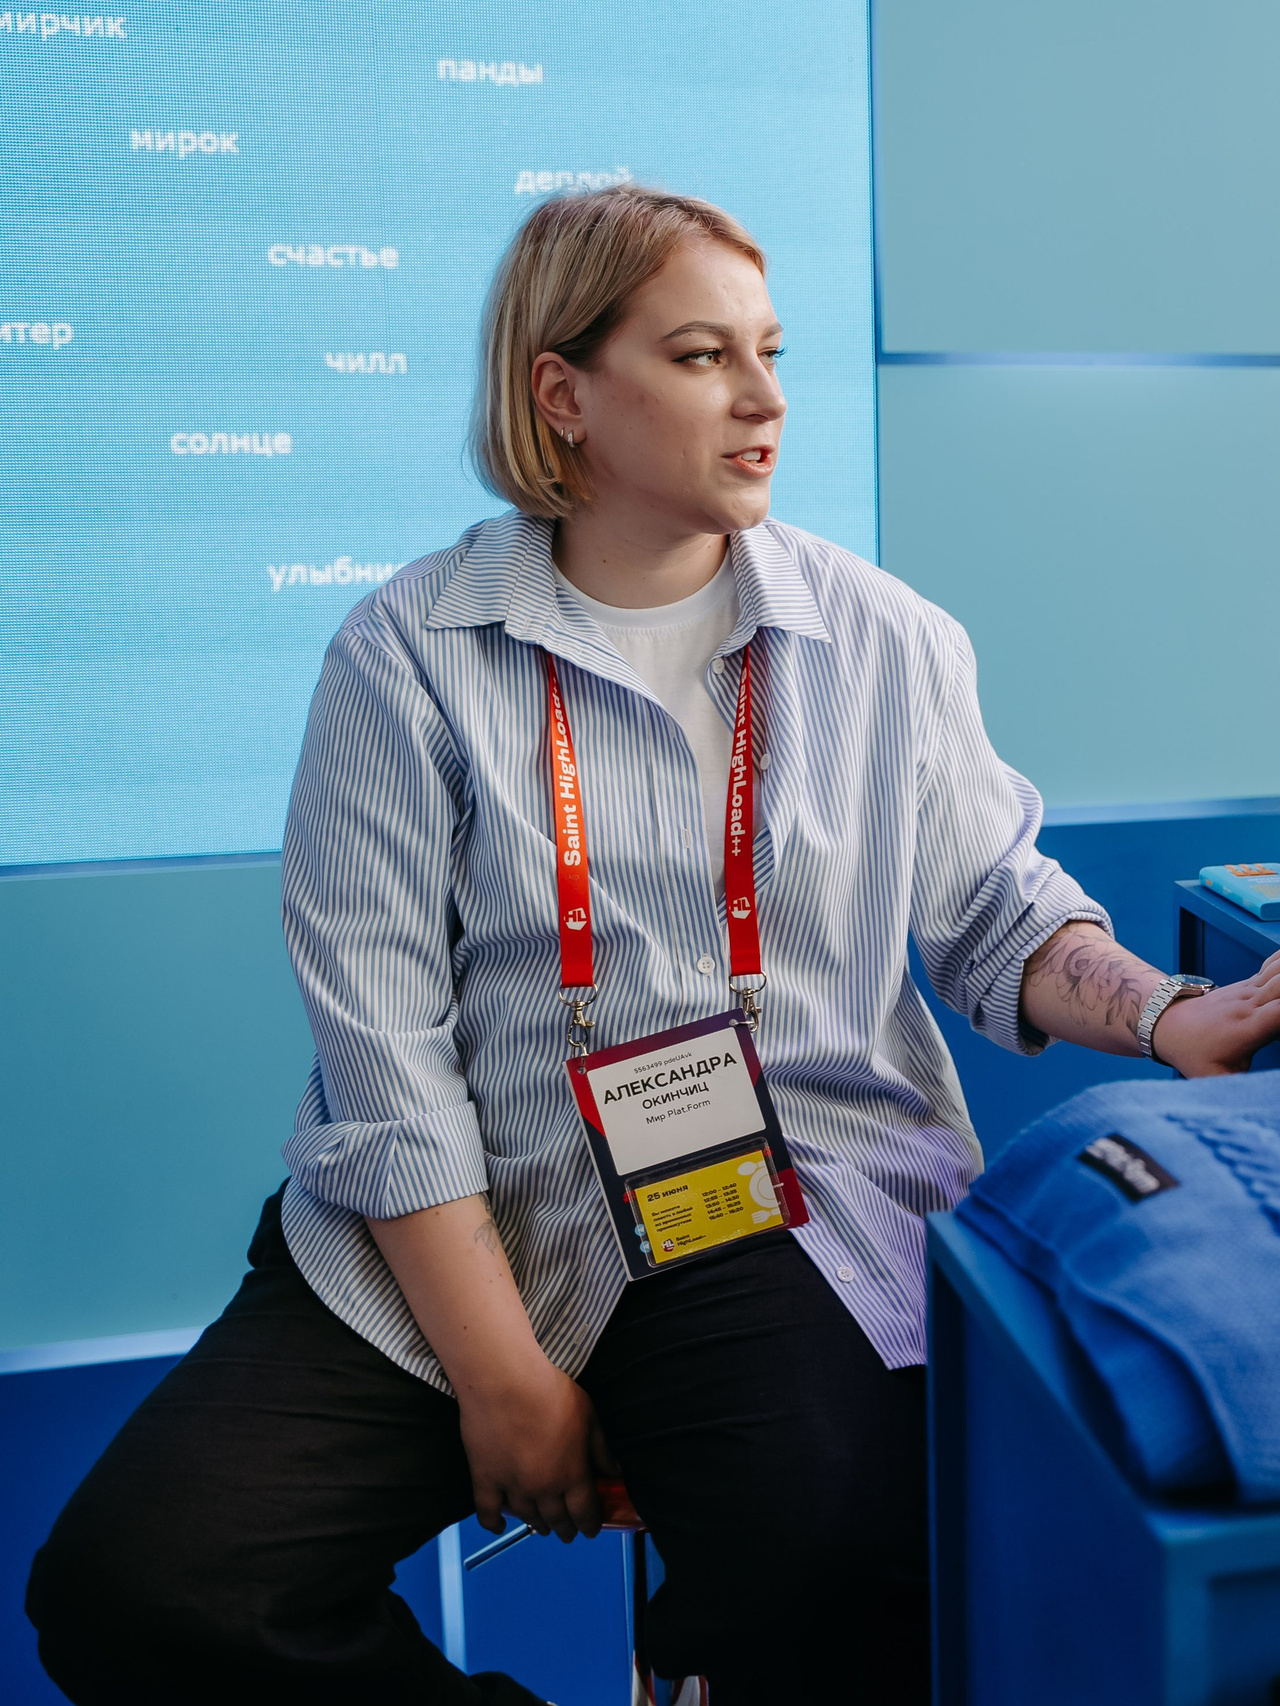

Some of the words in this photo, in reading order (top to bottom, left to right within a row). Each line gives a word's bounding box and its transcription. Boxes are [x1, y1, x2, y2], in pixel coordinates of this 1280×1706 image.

[438, 58, 543, 86] панды
[130, 128, 239, 158] мирок
[268, 243, 399, 269] счастье
[325, 352, 407, 374] чилл
[170, 430, 292, 457] солнце
[267, 556, 409, 592] улыбни
[737, 667, 748, 727] Saint
[731, 729, 747, 857] HighLoad++
[563, 804, 581, 867] Saint
[603, 1052, 737, 1105] АЛЕКСАНДРА
[642, 1081, 709, 1110] ОКИНЧИЦ
[646, 1113, 666, 1125] Мир
[667, 1100, 711, 1117] Plat.Form
[647, 1192, 661, 1202] 25
[662, 1185, 689, 1198] июня
